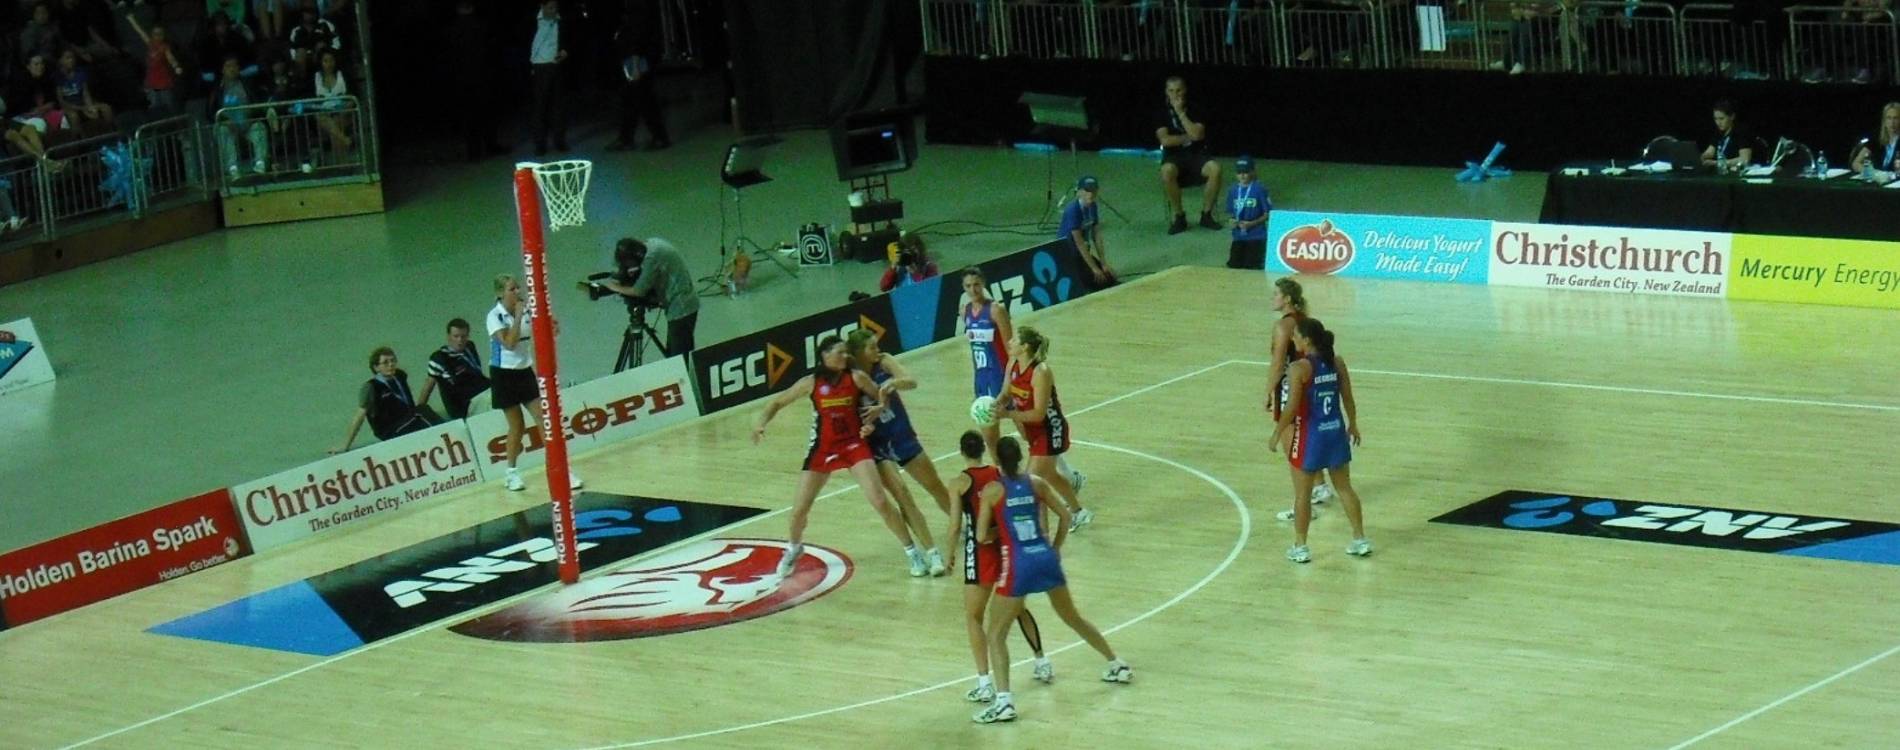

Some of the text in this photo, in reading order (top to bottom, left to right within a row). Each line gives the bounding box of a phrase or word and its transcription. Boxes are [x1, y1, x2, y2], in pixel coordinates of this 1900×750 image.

[1363, 230, 1483, 257] Delicious Yogurt
[1496, 231, 1723, 275] Christchurch
[524, 253, 538, 318] HOLDEN
[1375, 252, 1468, 281] Made Easy!
[1546, 273, 1565, 286] The
[1568, 275, 1610, 288] Garden
[1643, 279, 1671, 291] New
[1671, 280, 1721, 294] Zealand
[1740, 258, 1900, 292] Mercury Energy
[709, 350, 767, 399] ISC
[538, 376, 553, 441] HOLDEN
[1323, 396, 1332, 415] C
[246, 432, 471, 527] Christchurch
[308, 513, 330, 532] The
[332, 503, 375, 525] Garden
[405, 486, 431, 503] New
[431, 469, 477, 495] Zealand
[552, 501, 567, 564] HOLDEN
[1601, 504, 1852, 539] ANZ
[0, 515, 218, 600] Holden Barina Spark
[189, 560, 203, 571] Go
